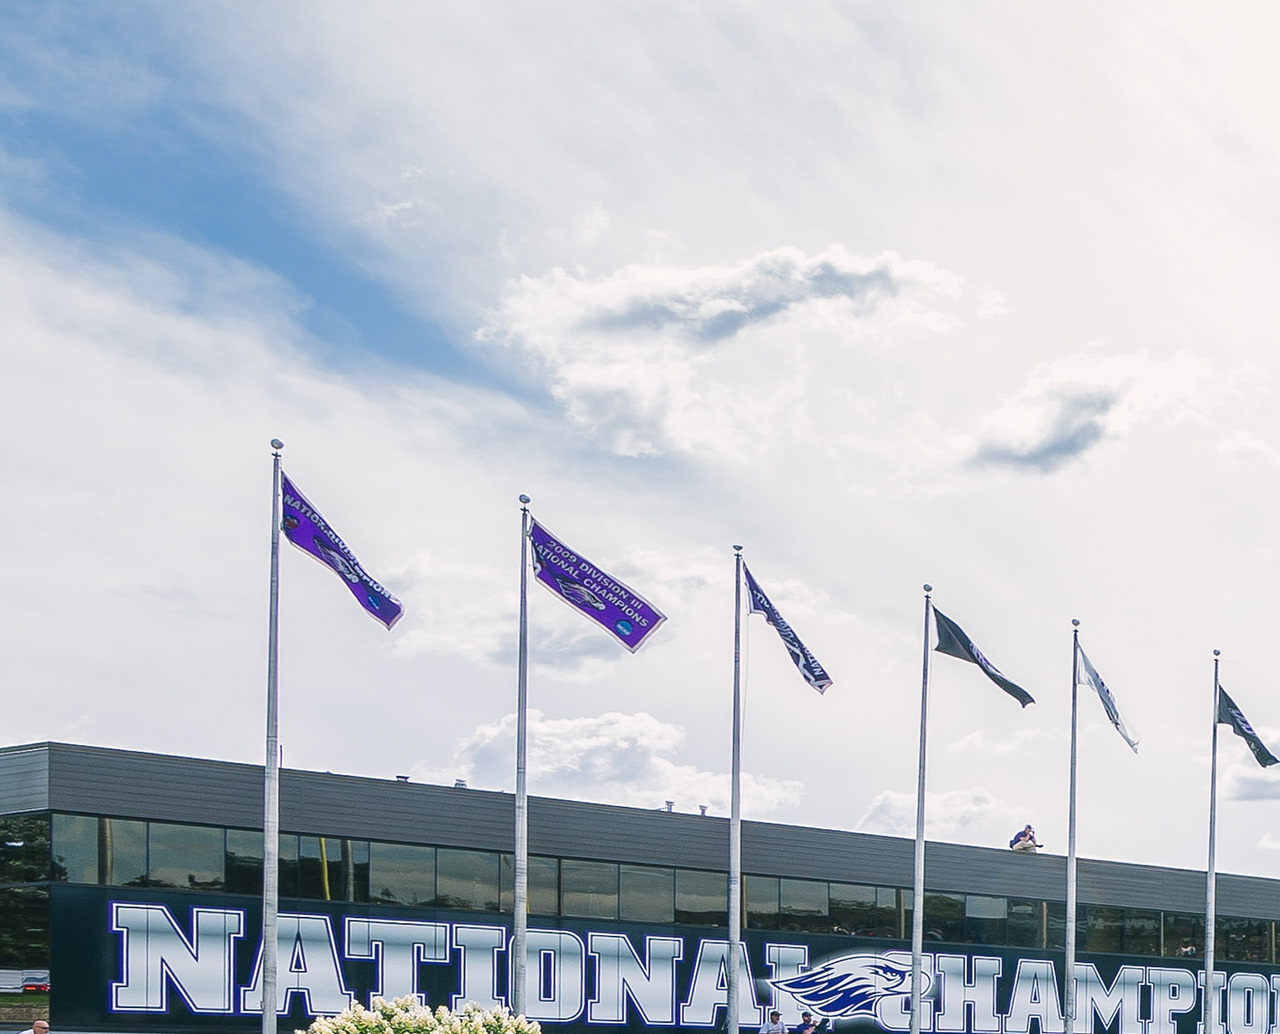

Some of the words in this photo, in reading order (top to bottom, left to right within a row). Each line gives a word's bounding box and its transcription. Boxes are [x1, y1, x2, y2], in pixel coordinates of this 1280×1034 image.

[546, 540, 578, 563] 2009
[579, 562, 629, 600] DIVISION
[630, 598, 643, 610] III
[582, 577, 650, 627] CHAMPIONS
